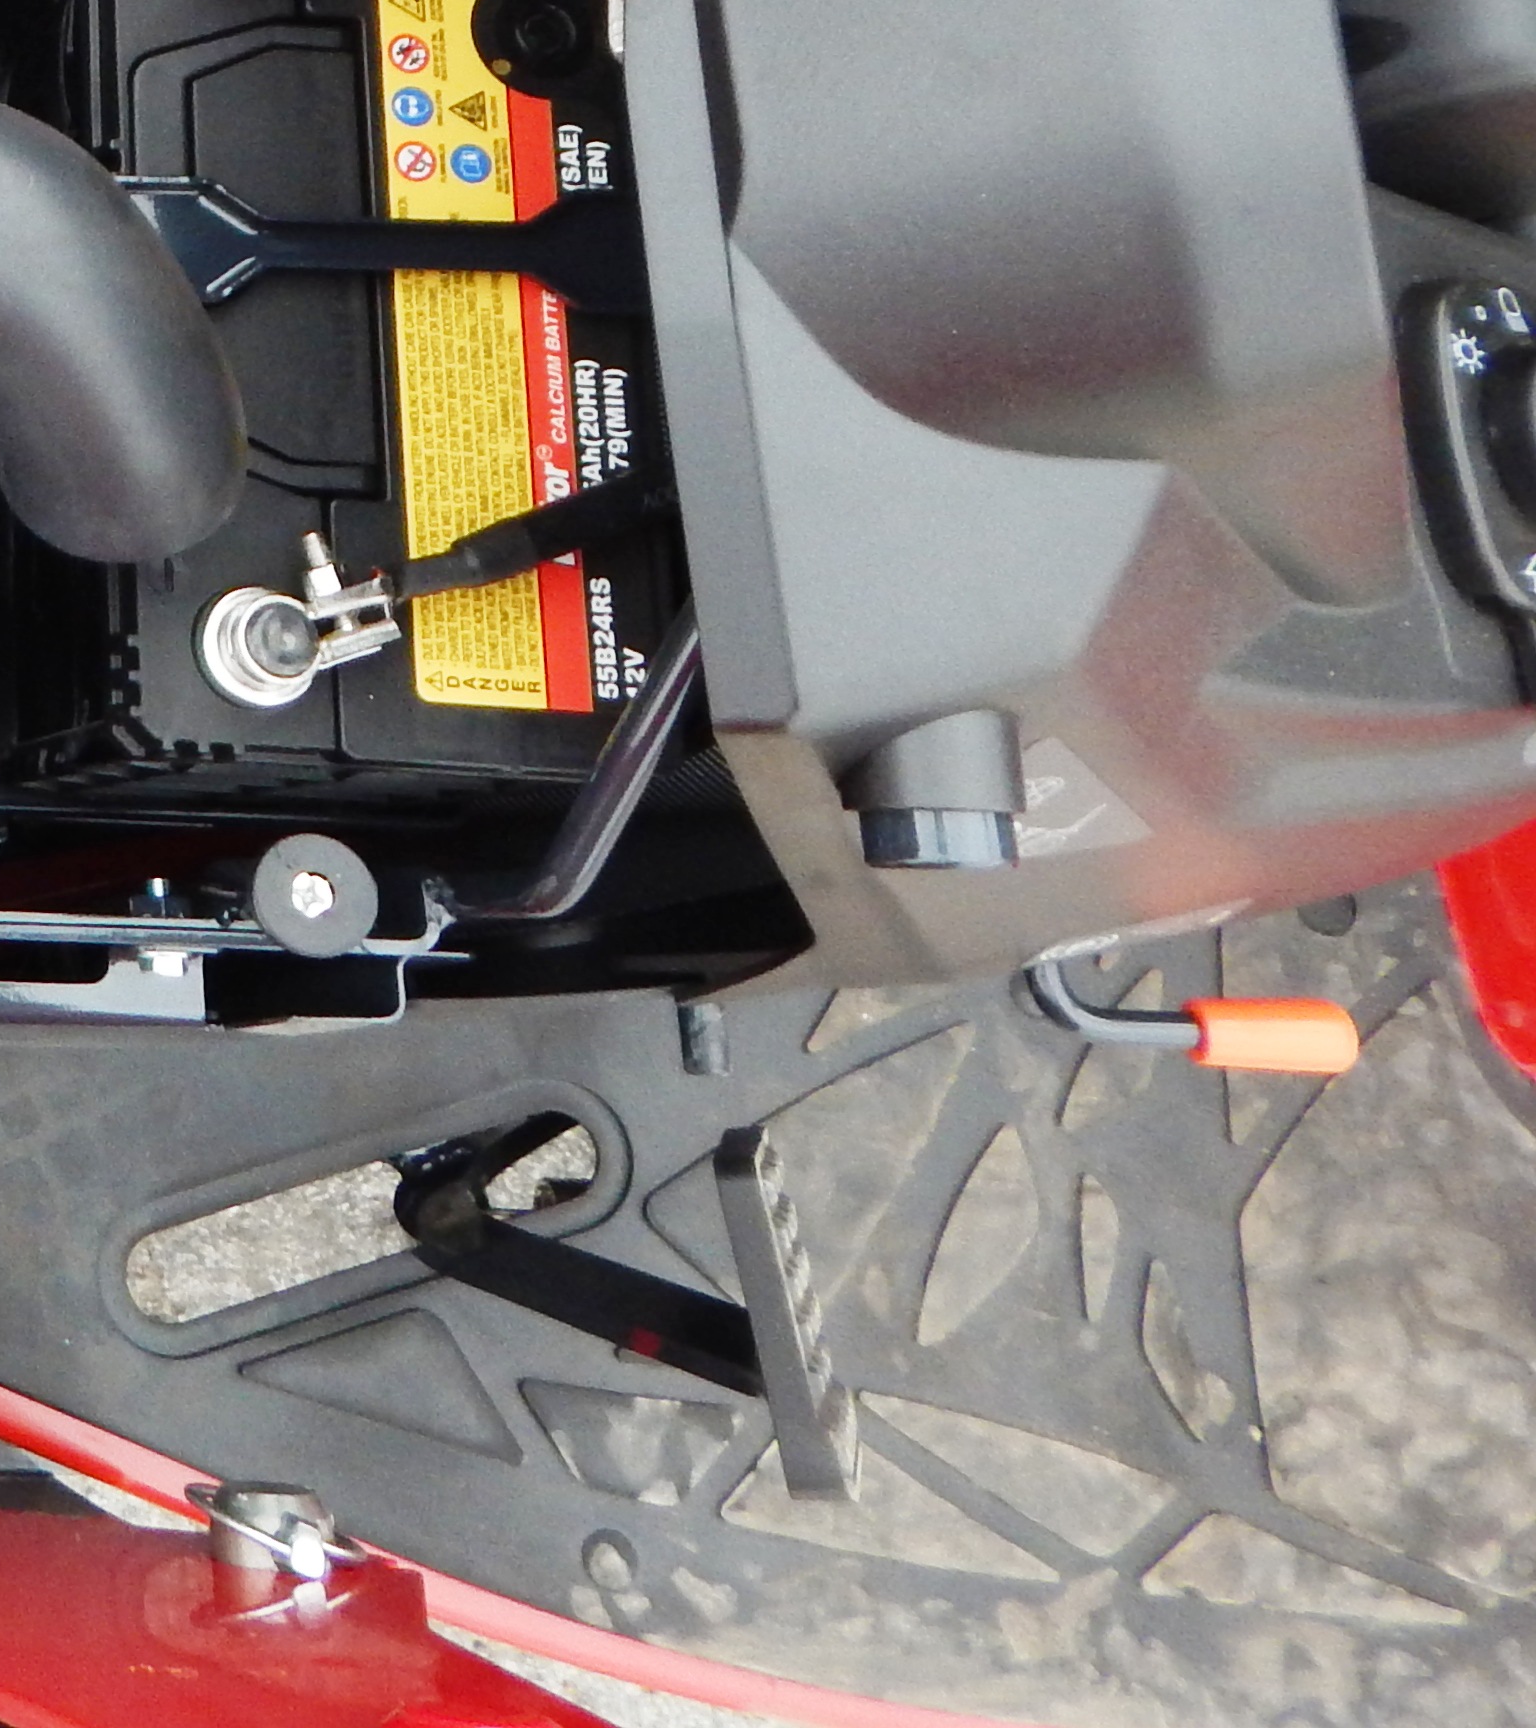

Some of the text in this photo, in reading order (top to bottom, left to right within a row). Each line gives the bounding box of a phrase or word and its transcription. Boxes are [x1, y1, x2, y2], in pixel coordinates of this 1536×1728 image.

[557, 124, 585, 192] (SAE)
[547, 356, 568, 445] CALCIUM
[589, 577, 619, 700] 55B24RS
